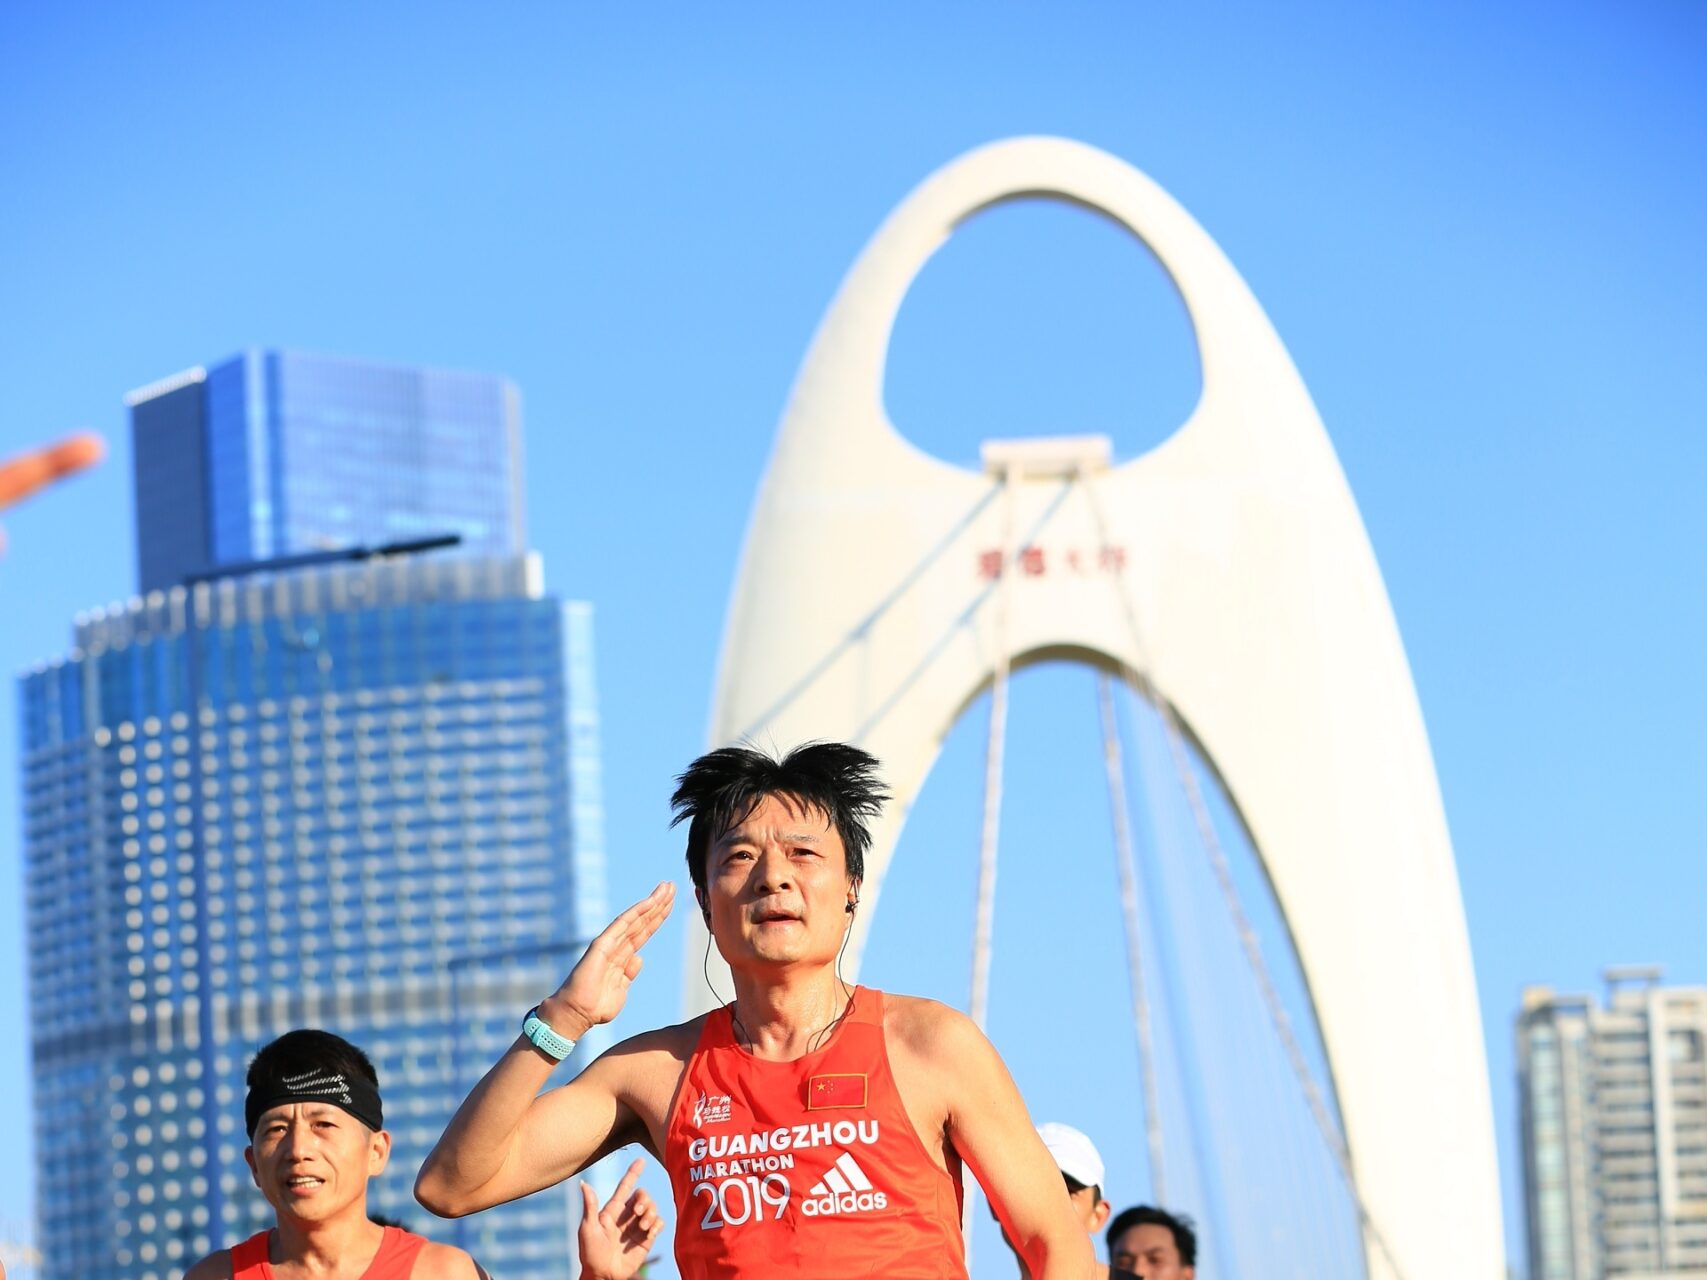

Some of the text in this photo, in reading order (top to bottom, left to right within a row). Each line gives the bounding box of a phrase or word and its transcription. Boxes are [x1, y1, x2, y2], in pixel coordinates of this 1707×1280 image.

[689, 1120, 879, 1161] GUANGZHOU
[689, 1153, 795, 1182] MARATHON
[692, 1172, 791, 1231] 2019
[801, 1190, 888, 1216] adidas
